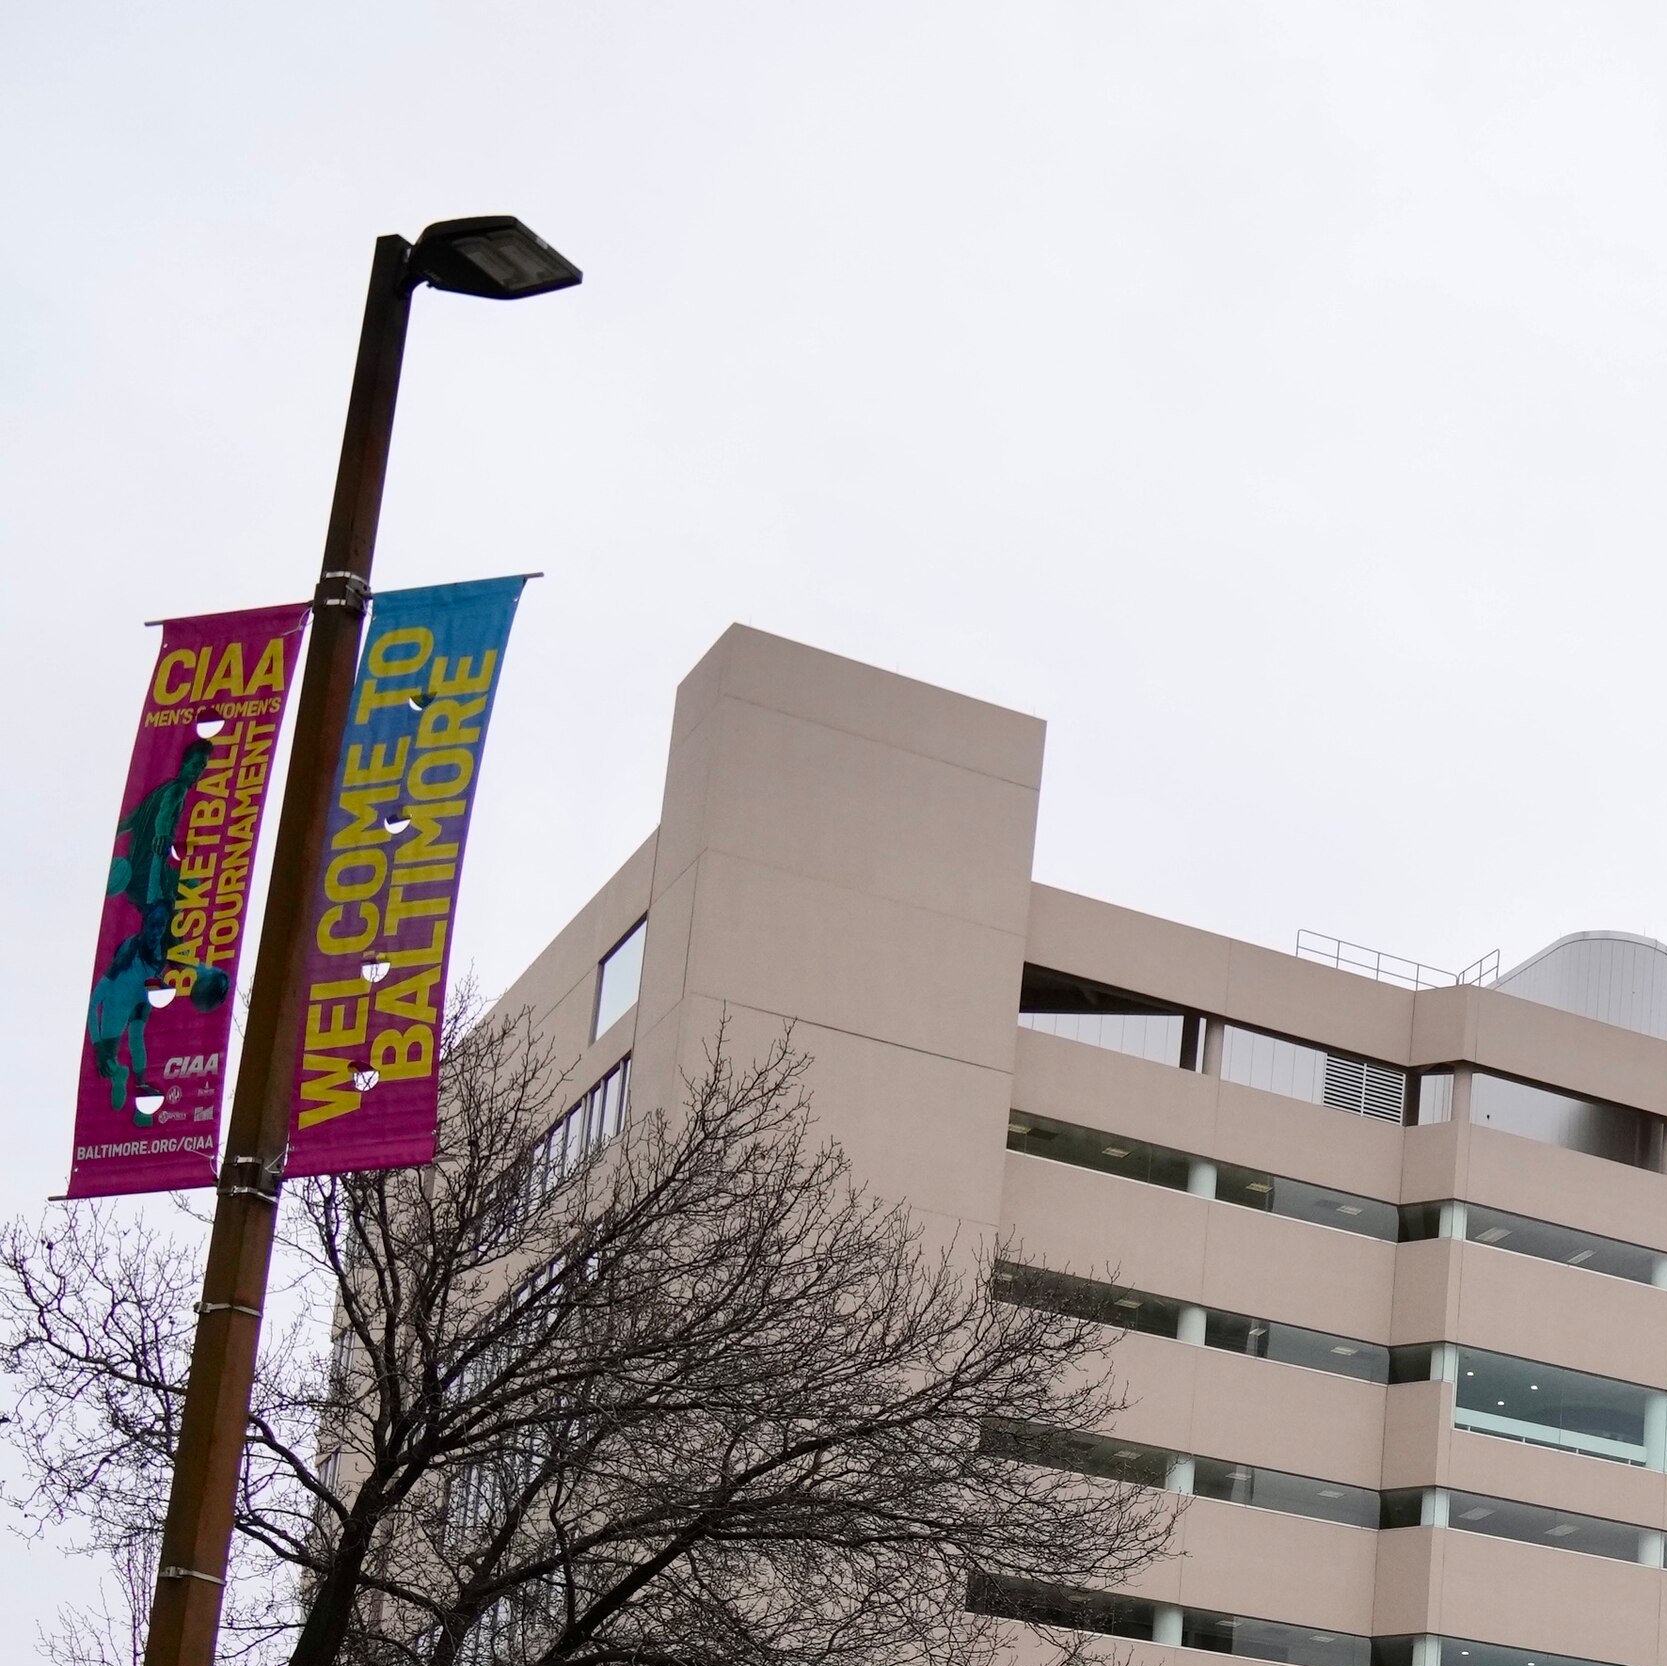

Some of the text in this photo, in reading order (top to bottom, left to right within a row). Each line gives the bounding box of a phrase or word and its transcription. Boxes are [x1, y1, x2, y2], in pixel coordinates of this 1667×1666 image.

[145, 708, 193, 728] MEN'S
[153, 638, 285, 705] CIAA
[164, 721, 243, 997] BASKETBALL
[206, 720, 276, 968] TOURNAMENT
[298, 627, 434, 1130] WELCOME TO
[370, 648, 498, 1081] BALTIMORE
[164, 1053, 219, 1079] CIAA
[77, 1135, 214, 1161] BALTIMORE.ORG/CIAA
